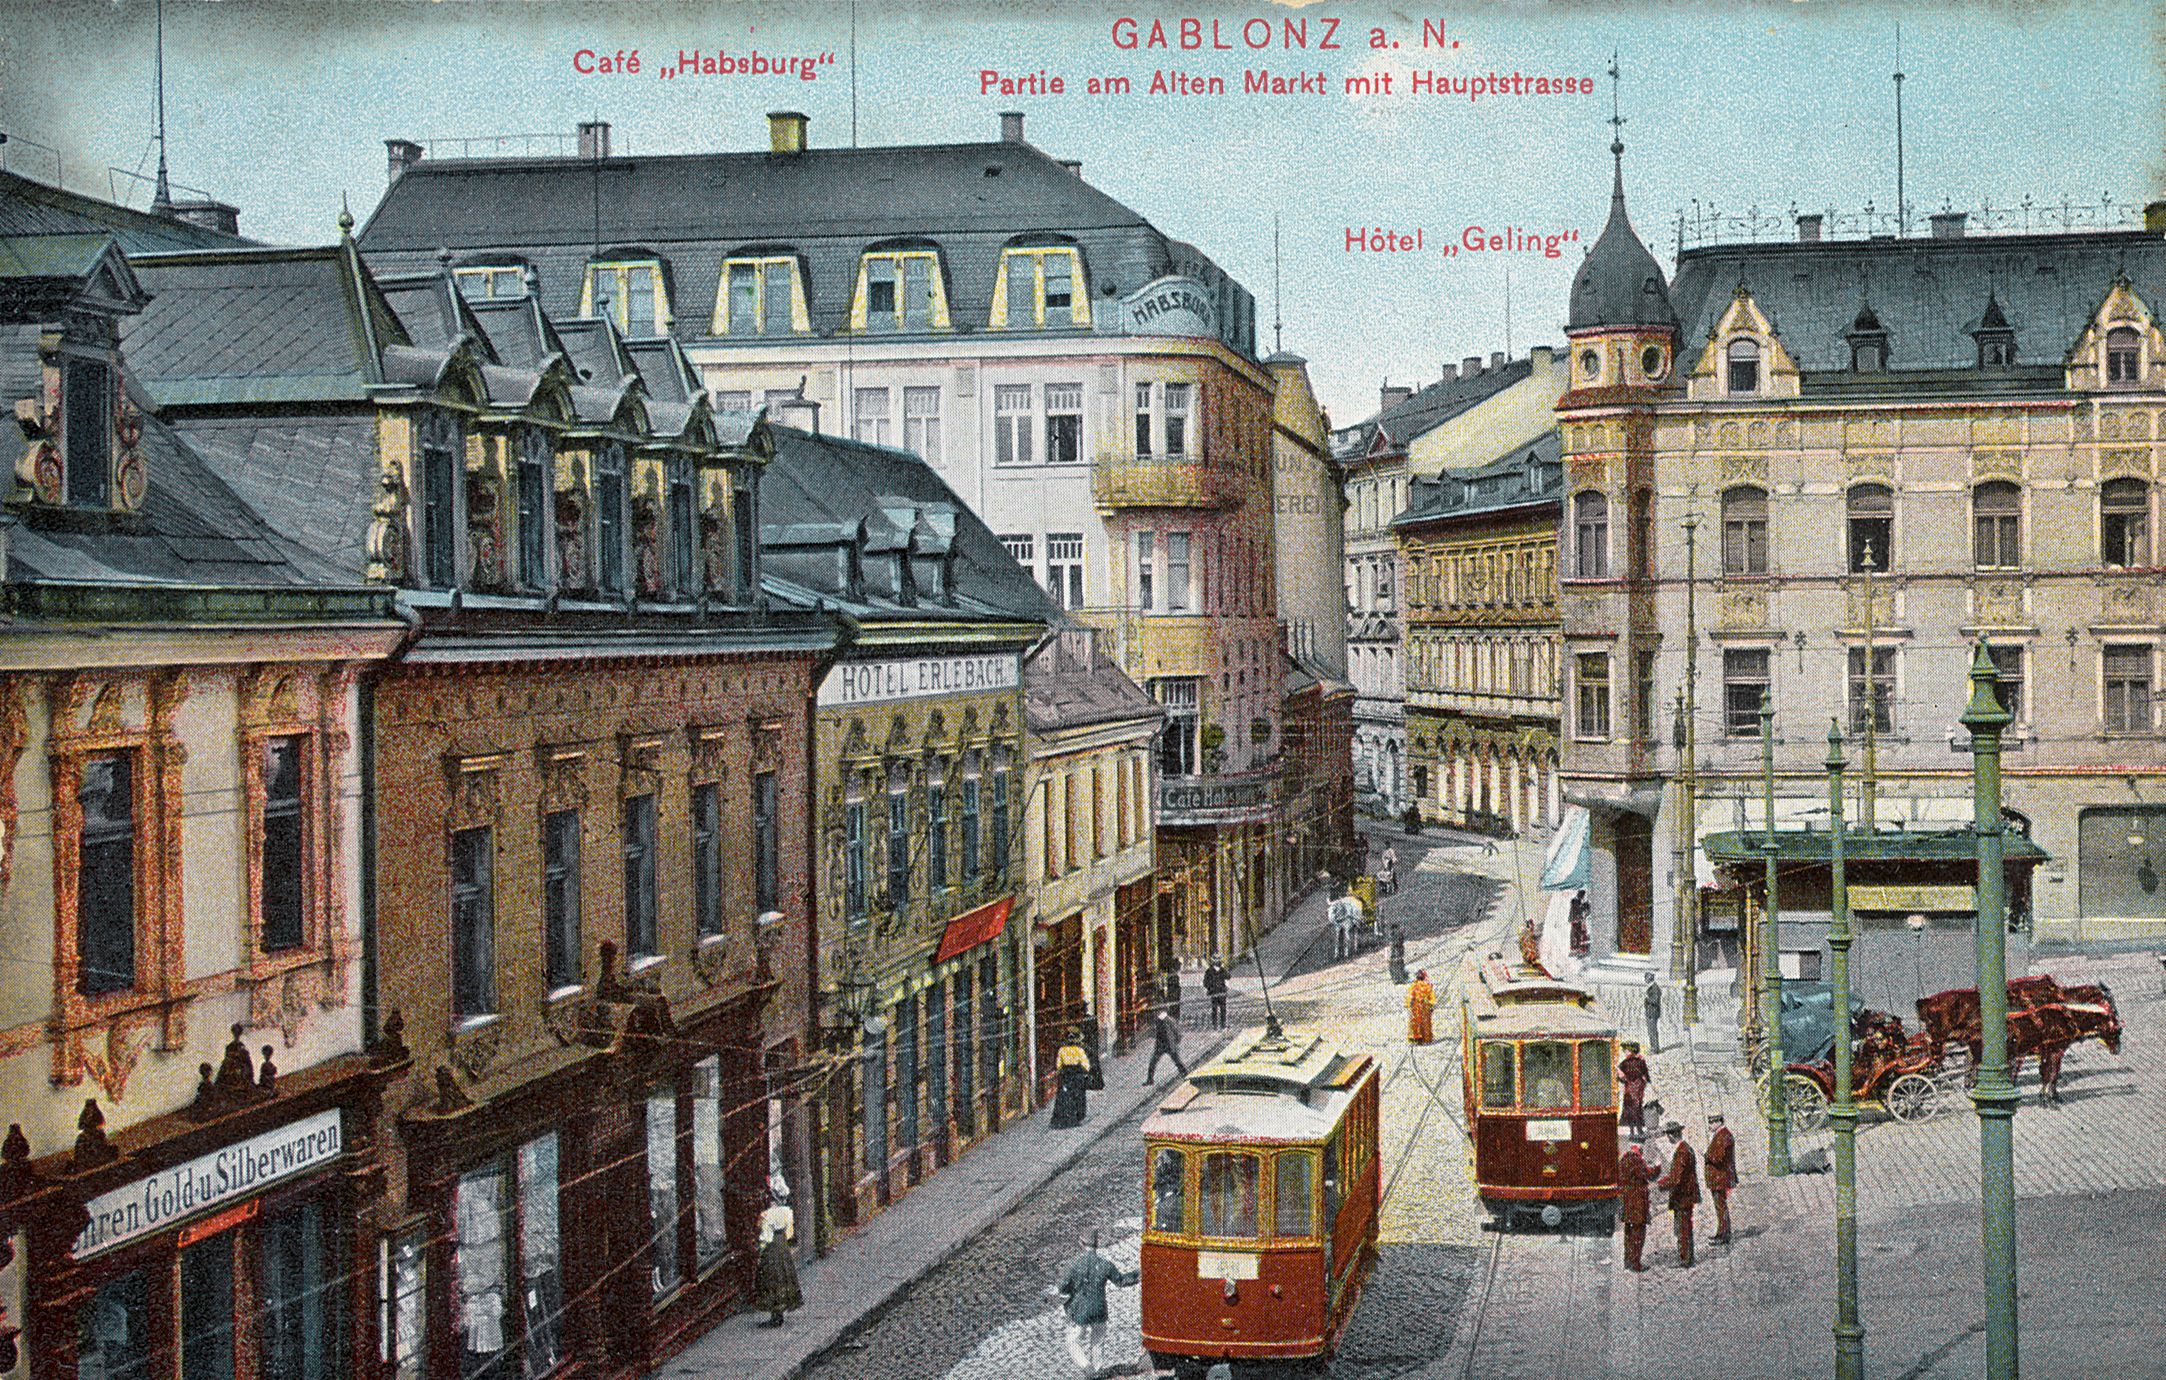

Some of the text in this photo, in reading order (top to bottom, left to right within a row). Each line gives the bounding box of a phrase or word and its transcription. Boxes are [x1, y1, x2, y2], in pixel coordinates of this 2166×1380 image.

[842, 658, 1004, 701] HOTEL ERLEBACH
[216, 1125, 338, 1195] Silberwaren
